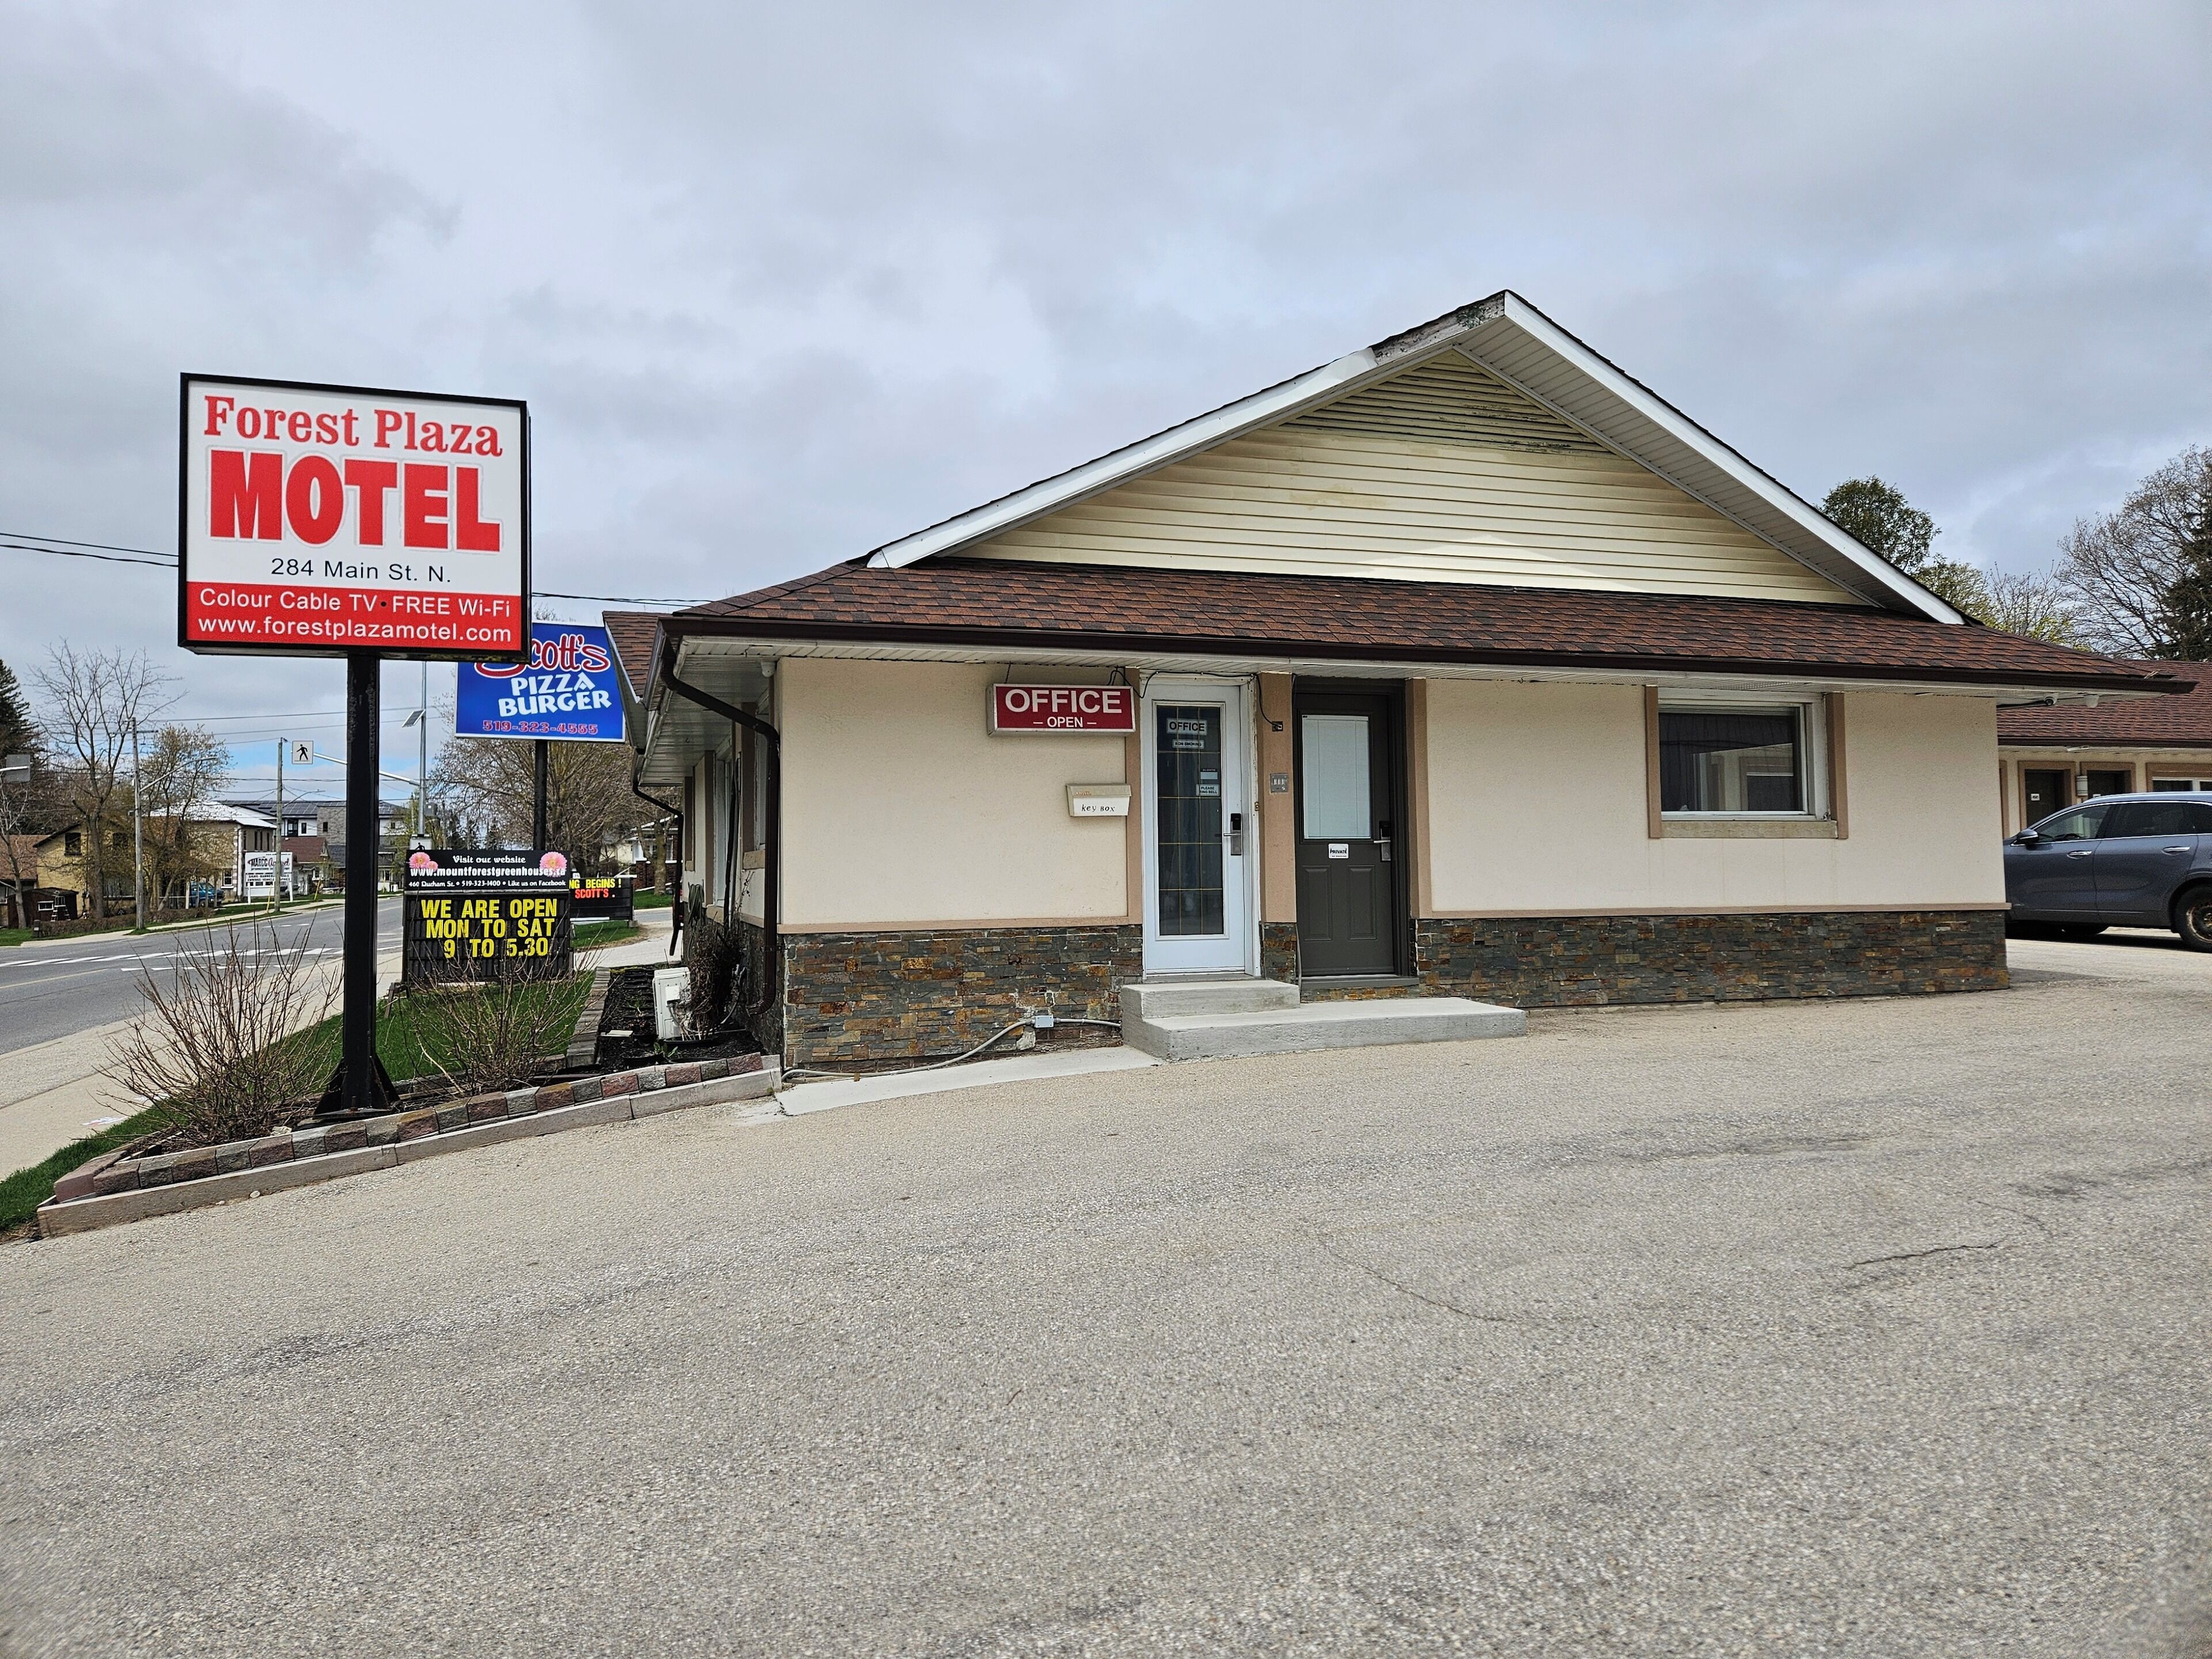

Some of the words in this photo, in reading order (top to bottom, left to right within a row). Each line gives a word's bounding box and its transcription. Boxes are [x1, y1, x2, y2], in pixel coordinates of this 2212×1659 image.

[204, 395, 359, 447] Forest
[374, 409, 503, 457] Plaza
[210, 449, 501, 553] MOTEL
[271, 558, 315, 577] 284
[324, 560, 378, 579] Main
[389, 563, 418, 581] St.
[428, 565, 451, 583] N.
[200, 588, 272, 609] Colour
[280, 591, 341, 611] Cable
[349, 594, 377, 612] TV
[392, 596, 450, 615] FREE
[458, 599, 510, 618] Wi-Fi
[198, 615, 512, 643] www.forestplazamotel.com
[474, 634, 611, 679] cott's
[510, 672, 596, 696] PIZZA
[498, 690, 612, 717] BURGER
[1005, 688, 1122, 714] OFFICE
[482, 719, 599, 735] 519-323-4555
[1047, 716, 1084, 728] OPEN
[1169, 721, 1205, 732] OFFICE
[1081, 804, 1097, 813] key
[452, 855, 474, 863] Visit
[494, 855, 527, 863] website
[575, 888, 609, 899] SCOTT'S
[585, 878, 616, 889] BEGINS
[421, 899, 452, 918] WE
[461, 899, 500, 918] ARE
[510, 899, 558, 918] OPEN
[426, 919, 469, 938] MON
[481, 918, 506, 937] TO
[518, 918, 555, 937] SAT
[444, 938, 456, 959] 9
[469, 938, 494, 957] TO
[506, 937, 549, 957] 5.30
